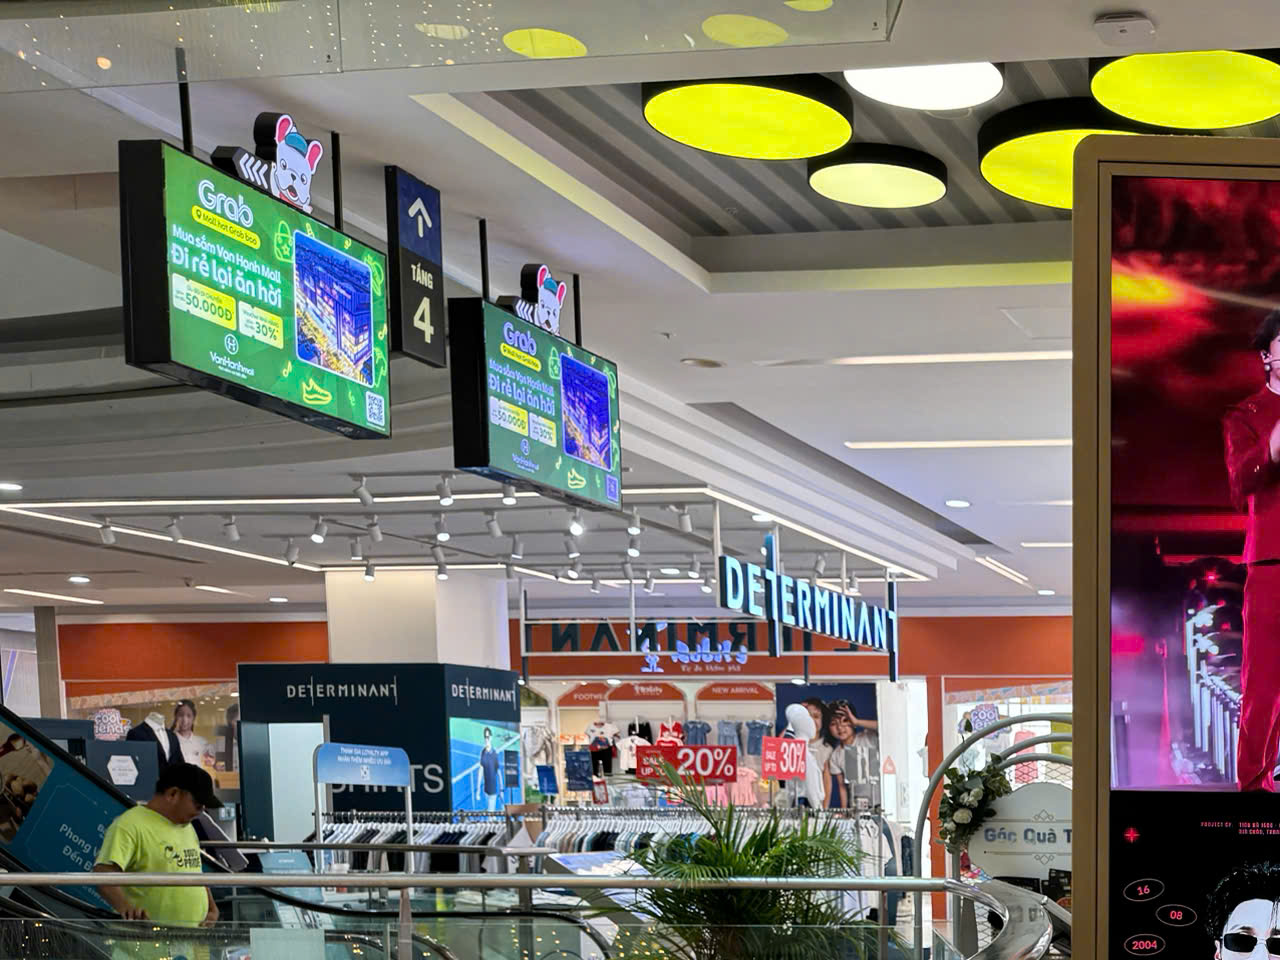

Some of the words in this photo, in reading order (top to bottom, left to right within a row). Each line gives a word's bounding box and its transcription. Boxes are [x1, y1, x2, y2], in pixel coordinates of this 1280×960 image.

[198, 179, 254, 228] Grab
[172, 224, 194, 244] Mua
[195, 235, 216, 254] sắm
[261, 264, 281, 283] Mall
[171, 243, 189, 269] Đi
[192, 253, 209, 277] rẻ
[212, 259, 232, 289] lại
[235, 269, 256, 297] ăn
[258, 279, 282, 308] hời
[413, 297, 435, 343] 4
[503, 321, 537, 356] Grab
[719, 534, 900, 682] DETERMINANT
[286, 676, 398, 706] DETERMINANT
[451, 677, 517, 710] DETERMINANT
[712, 686, 728, 695] NEW
[730, 686, 759, 695] ARRIVAL
[677, 748, 734, 776] 20%
[780, 741, 806, 773] 30%
[59, 823, 92, 854] Phong
[983, 828, 1018, 844] Góc
[1023, 827, 1057, 845] Quà
[62, 845, 84, 867] Đến
[1137, 884, 1151, 896] 16
[1169, 910, 1183, 920] 08
[1132, 940, 1158, 950] 2004
